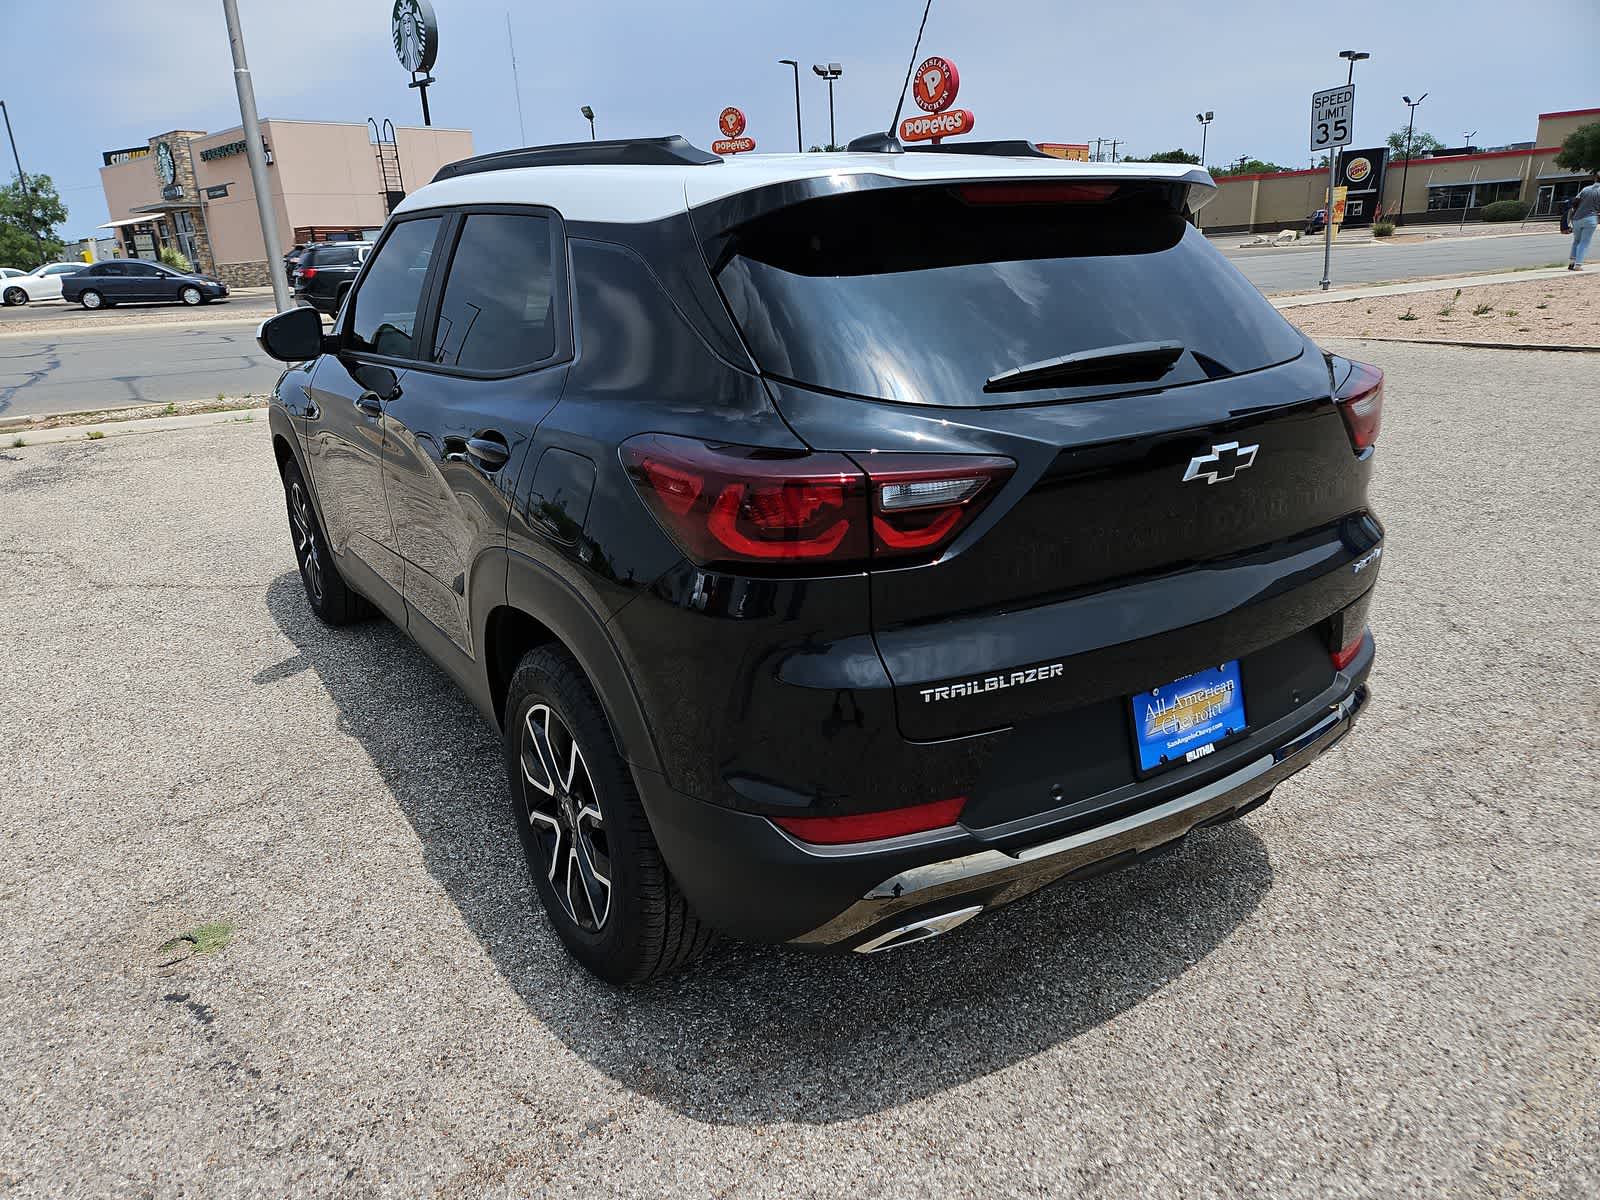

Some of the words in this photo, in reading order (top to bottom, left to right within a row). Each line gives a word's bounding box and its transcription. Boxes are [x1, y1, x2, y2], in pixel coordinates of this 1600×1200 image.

[915, 59, 950, 84] LOUISIANA
[923, 69, 941, 98] P
[915, 90, 949, 110] KITCHEN
[1314, 91, 1352, 109] SPEED
[1318, 105, 1347, 121] LIMIT
[725, 113, 737, 129] P
[1315, 119, 1348, 145] 35
[920, 663, 1064, 703] TRAILBLAZER
[1145, 697, 1168, 722] All
[1172, 678, 1235, 712] American
[1161, 701, 1223, 735] Chevrolet
[1166, 722, 1223, 749] SanAngeloChevy.com
